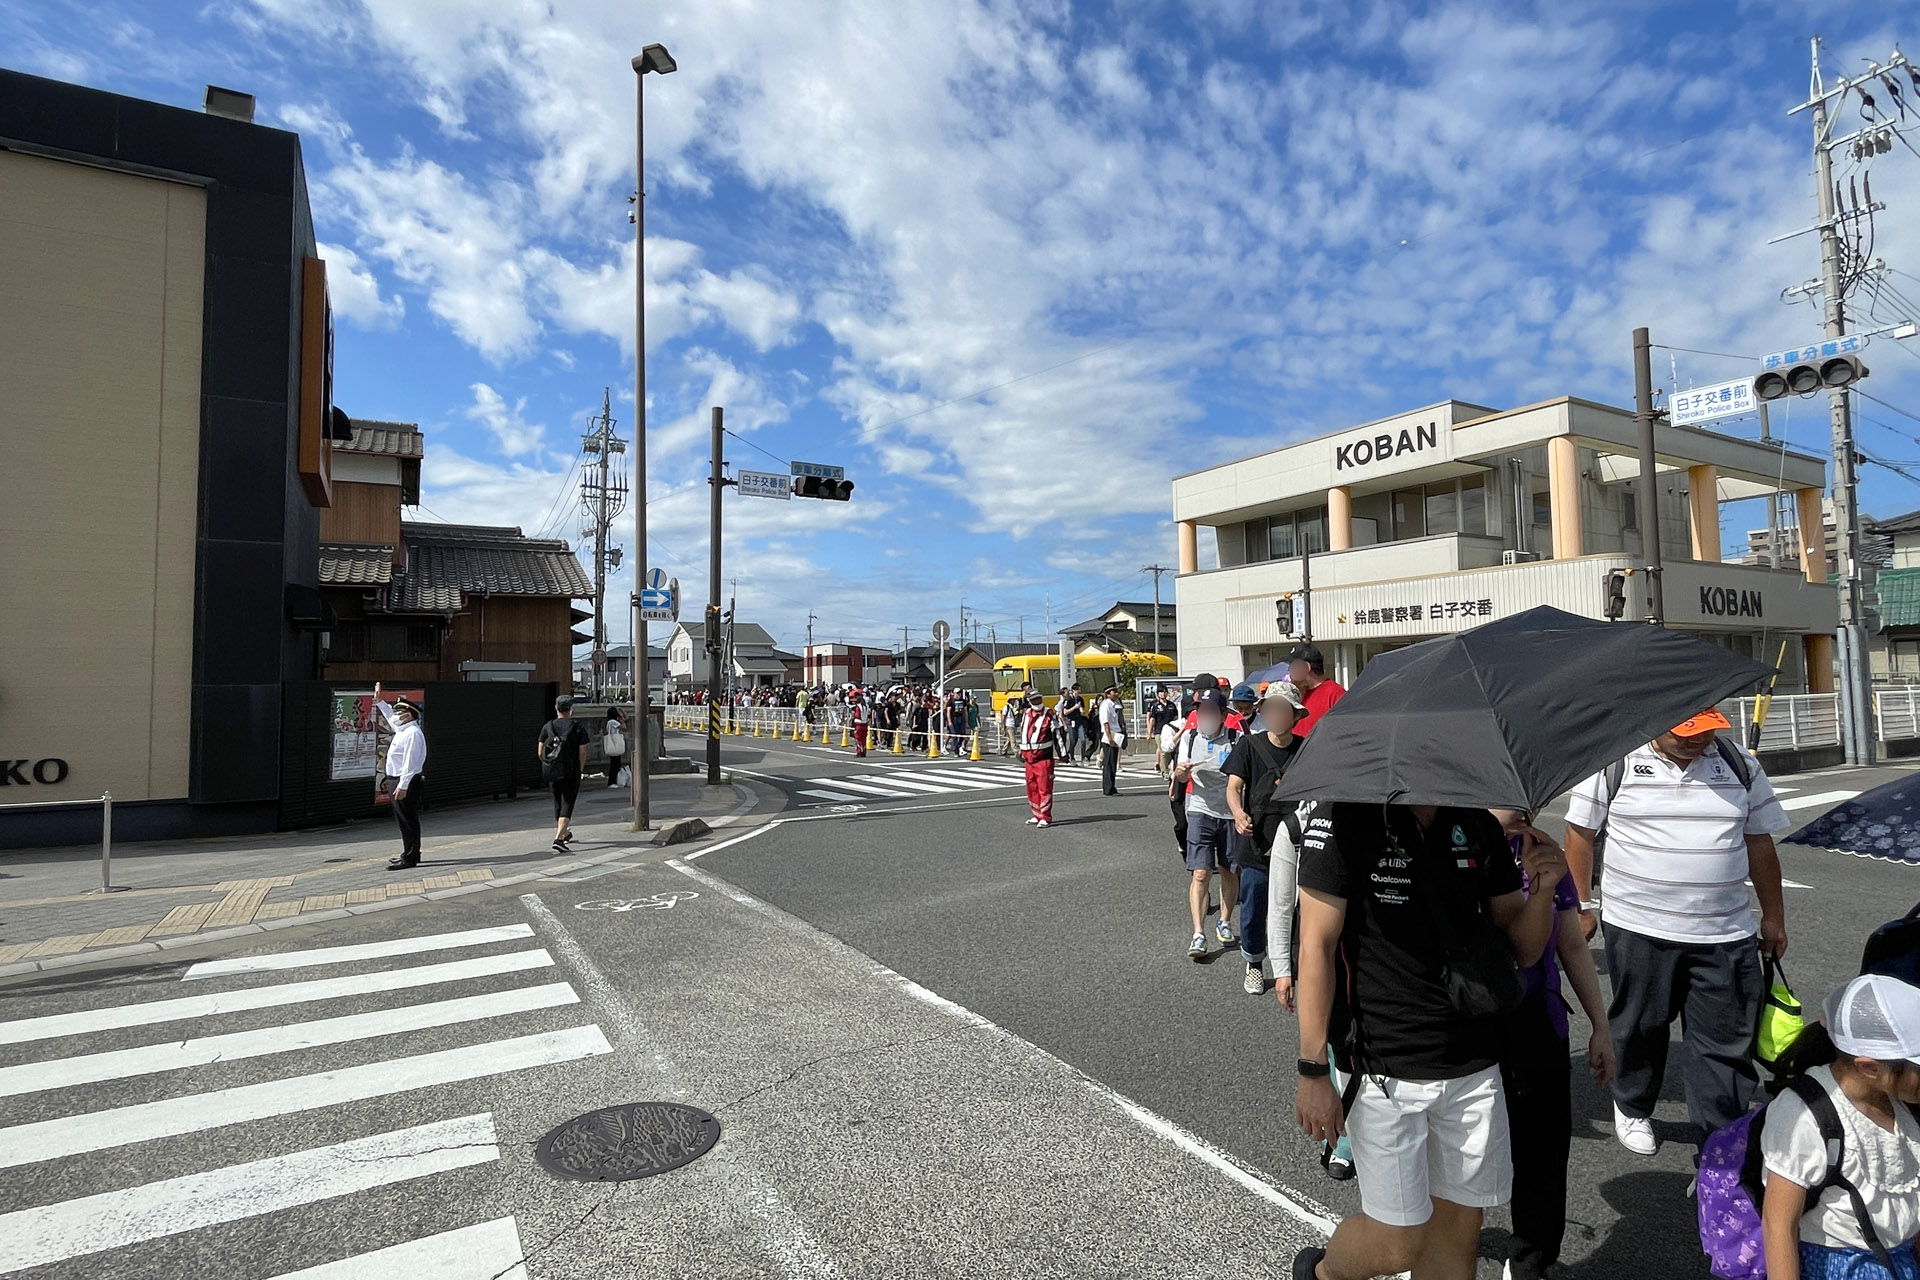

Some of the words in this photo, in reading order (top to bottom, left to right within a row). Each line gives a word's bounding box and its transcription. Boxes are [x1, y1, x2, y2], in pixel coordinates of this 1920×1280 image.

[1765, 337, 1860, 369] 歩車分離式
[1676, 384, 1747, 412] 白子交番前
[1676, 408, 1705, 421] Shiroko
[1707, 403, 1731, 414] Police
[1734, 399, 1750, 409] Box
[1336, 421, 1437, 471] KOBAN
[742, 474, 787, 489] 白子交番前
[1354, 605, 1423, 625] 鈴鹿警察署
[1430, 599, 1493, 620] 白子交番
[1699, 585, 1763, 618] KOBAN
[1388, 858, 1407, 869] UBS
[1371, 873, 1411, 884] Qualcomm
